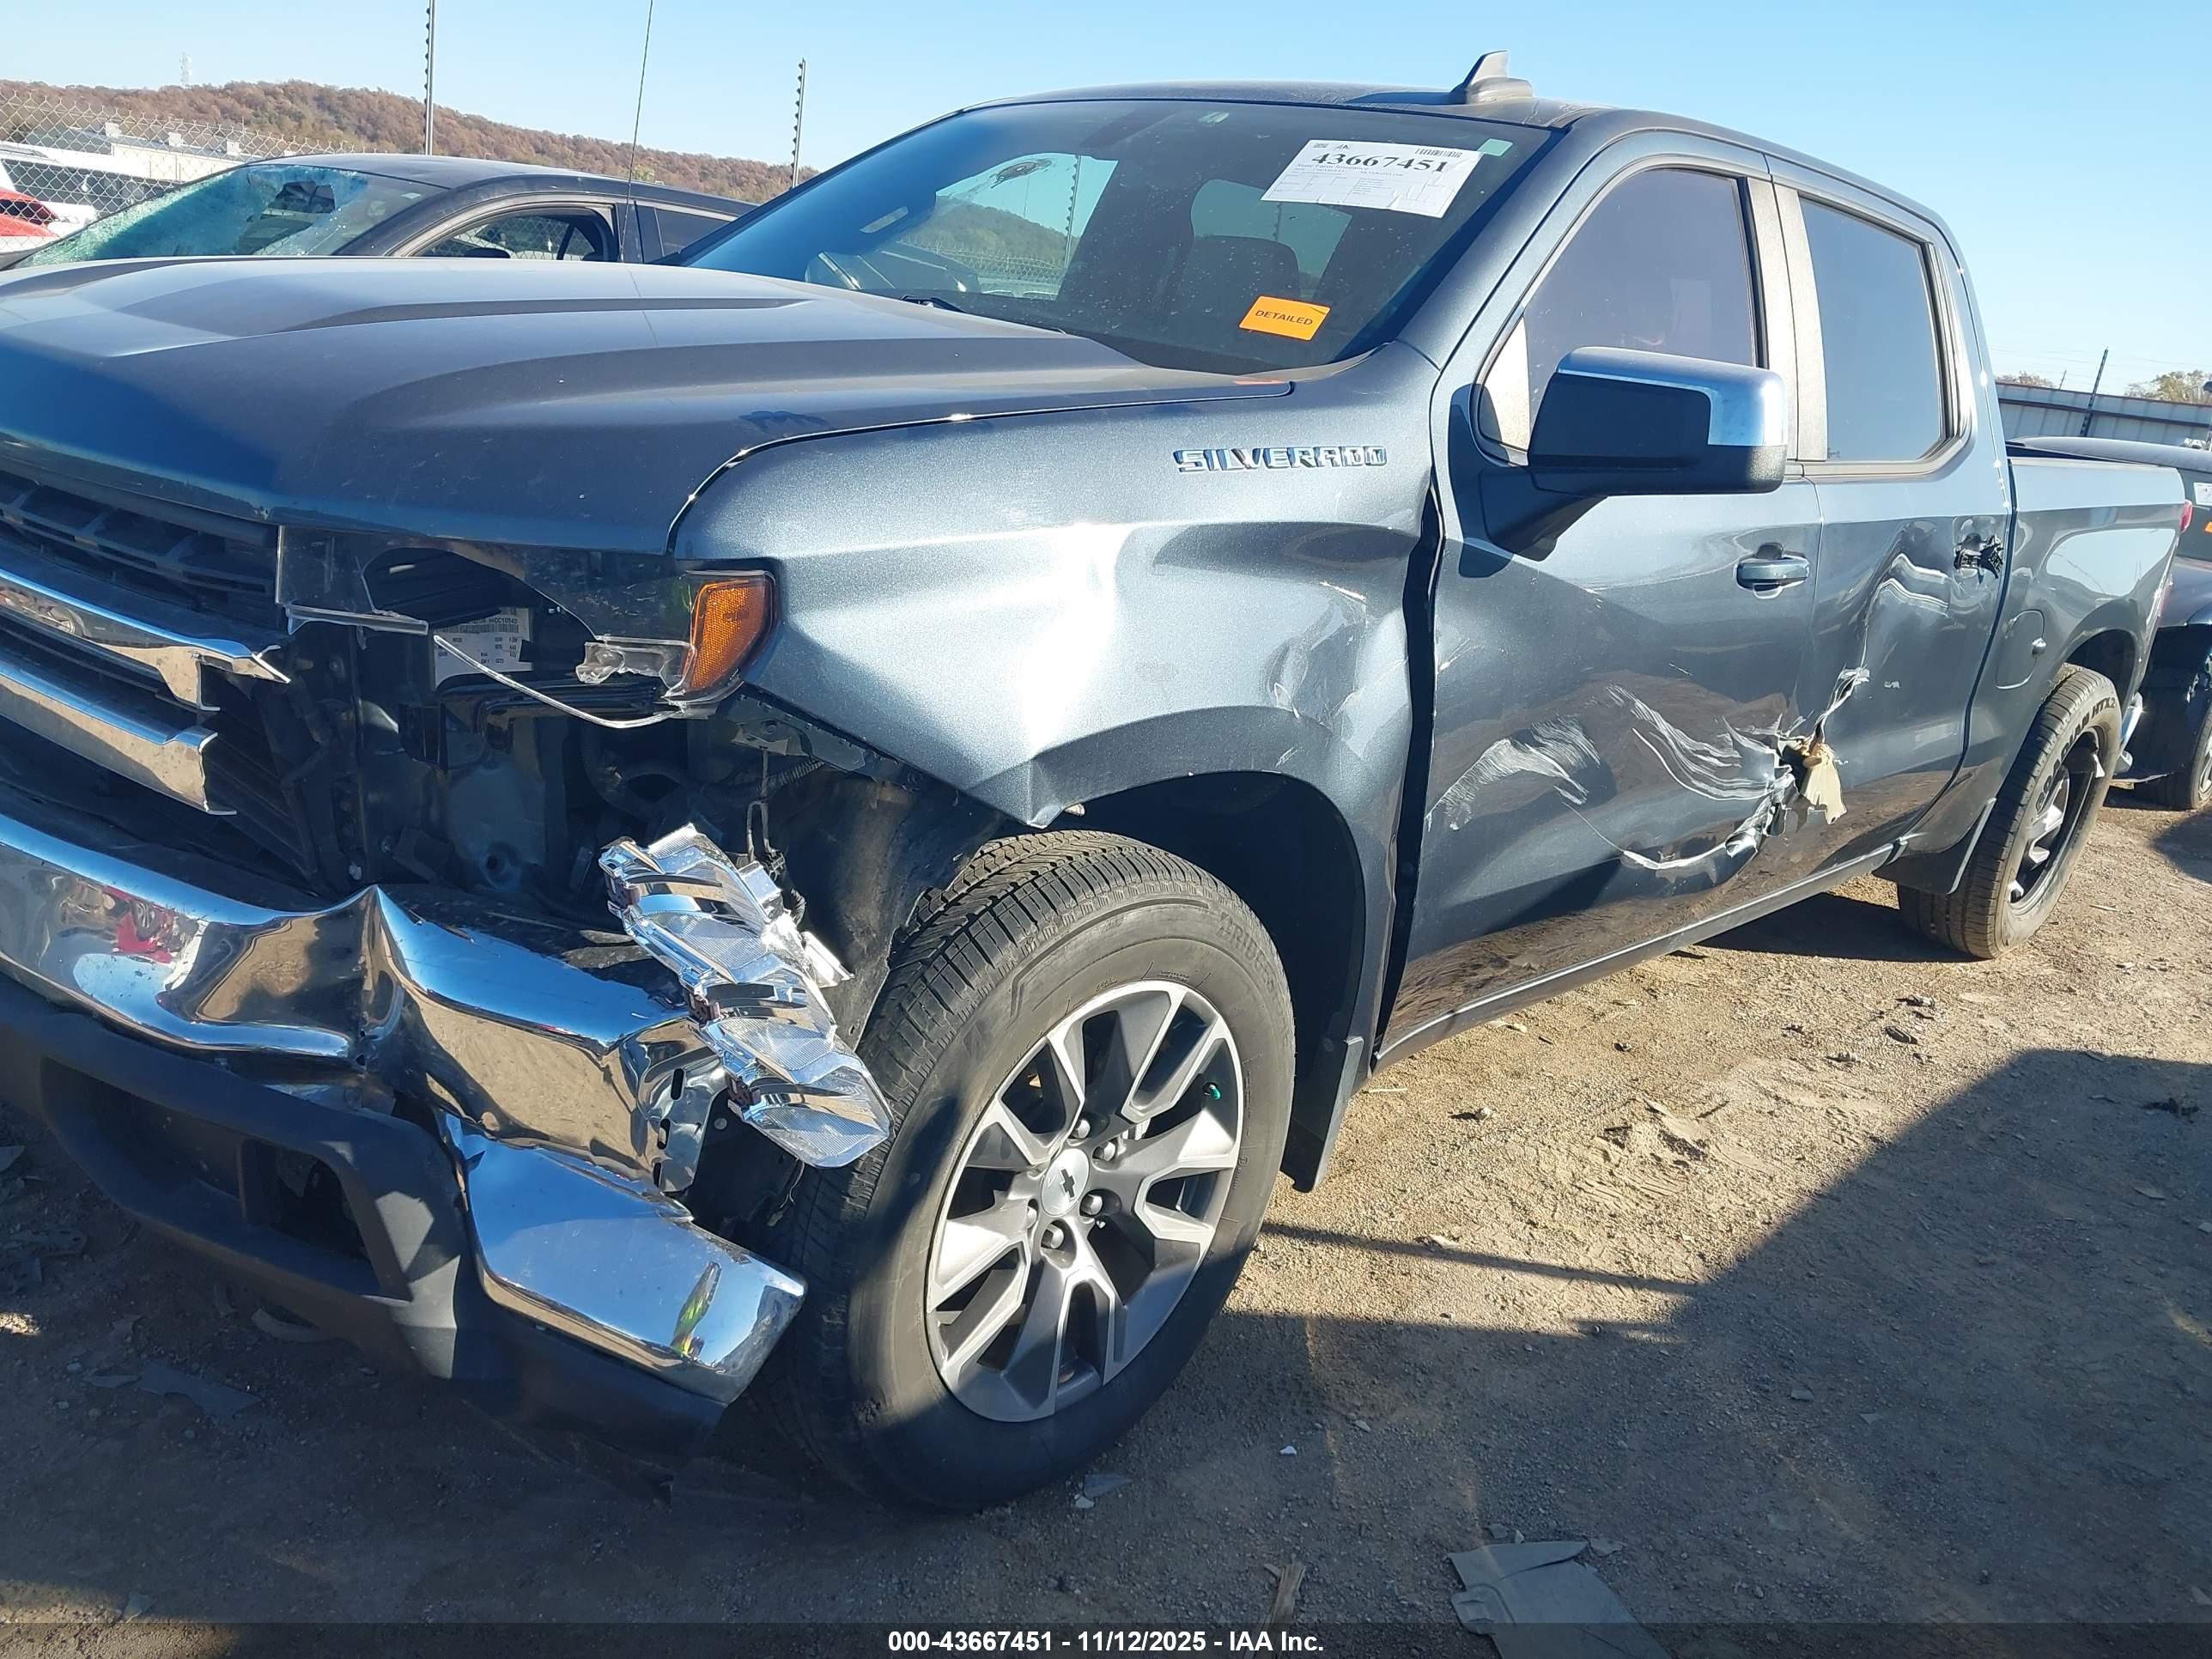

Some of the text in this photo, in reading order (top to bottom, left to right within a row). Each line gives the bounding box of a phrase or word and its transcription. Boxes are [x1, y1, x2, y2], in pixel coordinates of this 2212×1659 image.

[1311, 153, 1448, 173] 43667451
[1255, 310, 1313, 325] DETAILED
[1172, 446, 1388, 472] SILVERADO
[2091, 696, 2117, 720] HTX2
